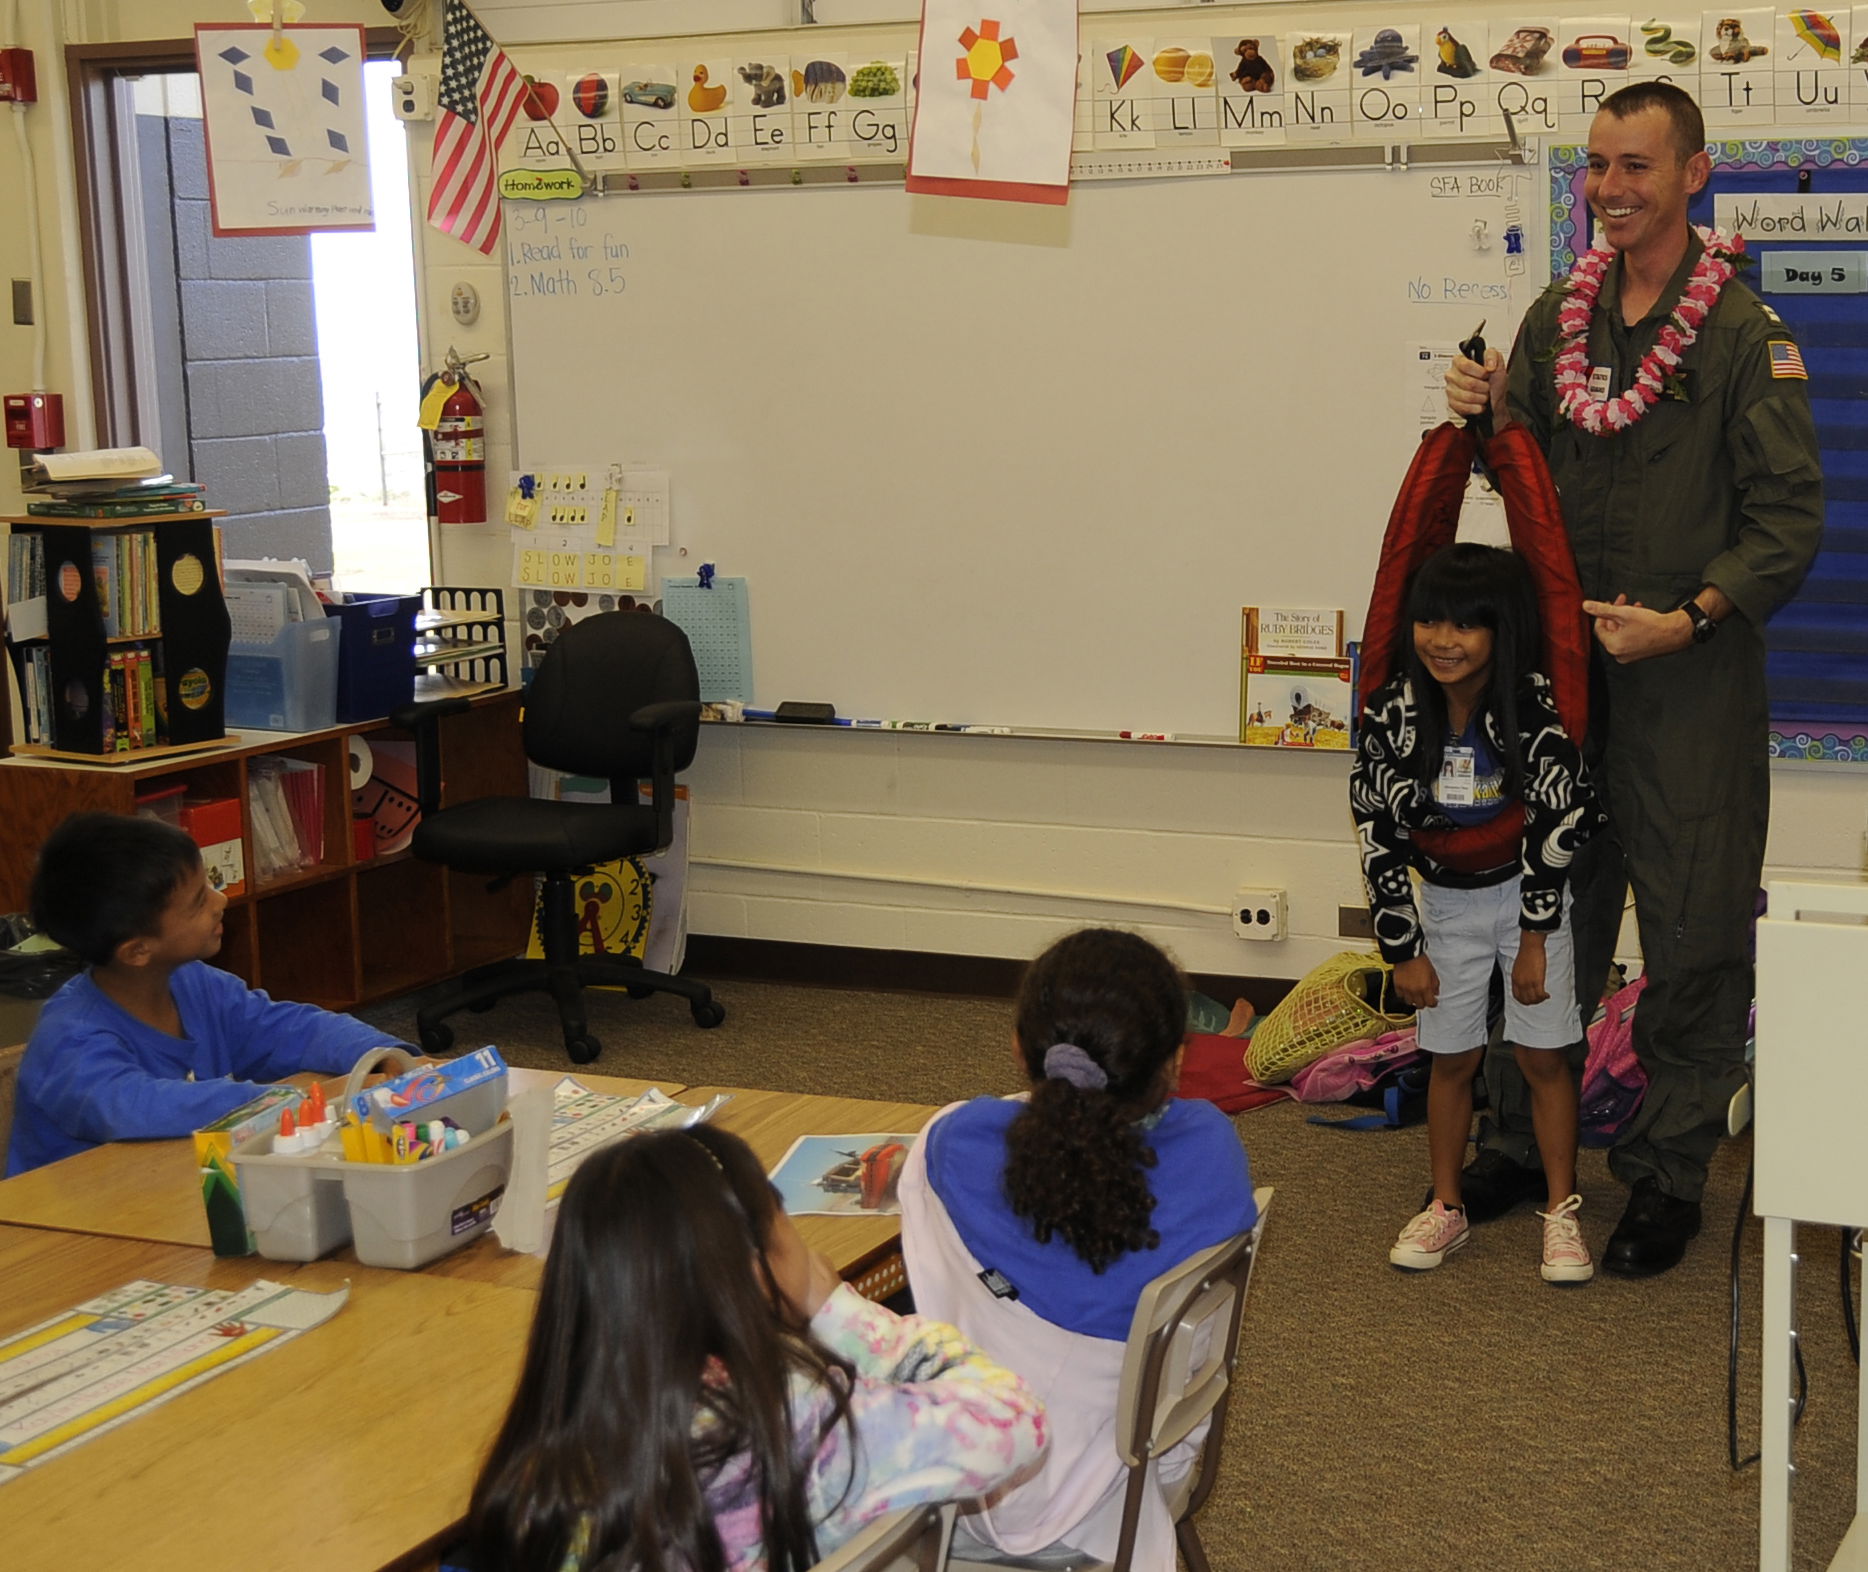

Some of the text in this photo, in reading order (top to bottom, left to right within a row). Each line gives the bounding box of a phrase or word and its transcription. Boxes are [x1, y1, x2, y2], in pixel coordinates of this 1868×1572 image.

[1581, 79, 1606, 113] R
[1720, 72, 1753, 107] Tt
[1796, 70, 1839, 105] Uu
[1110, 99, 1142, 132] Kk
[1172, 97, 1197, 130] Ll
[1223, 96, 1283, 130] Mm
[1295, 91, 1334, 124] Nn
[1360, 88, 1408, 121] Oo
[1434, 85, 1476, 132] Pp
[1498, 82, 1555, 128] Qq
[524, 127, 560, 157] Aa
[578, 123, 616, 154] Bb
[634, 121, 670, 151] Cc
[691, 117, 729, 149] Dd
[753, 114, 784, 145] Ee
[807, 111, 838, 143] Ff
[852, 110, 898, 153] Gg
[504, 177, 575, 193] Homework
[1430, 176, 1462, 194] SFA
[1735, 200, 1807, 232] Word
[568, 237, 594, 260] for
[604, 233, 629, 261] fun
[1408, 276, 1431, 300] No
[1784, 267, 1846, 286] Day 5
[1260, 623, 1334, 636] RUBY BRIDGES
[1274, 612, 1321, 624] The Story of
[1250, 656, 1263, 666] IF
[619, 859, 624, 874] 1
[629, 879, 639, 895] 2
[631, 904, 641, 921] 3
[619, 930, 630, 945] 4
[475, 1050, 497, 1068] 11
